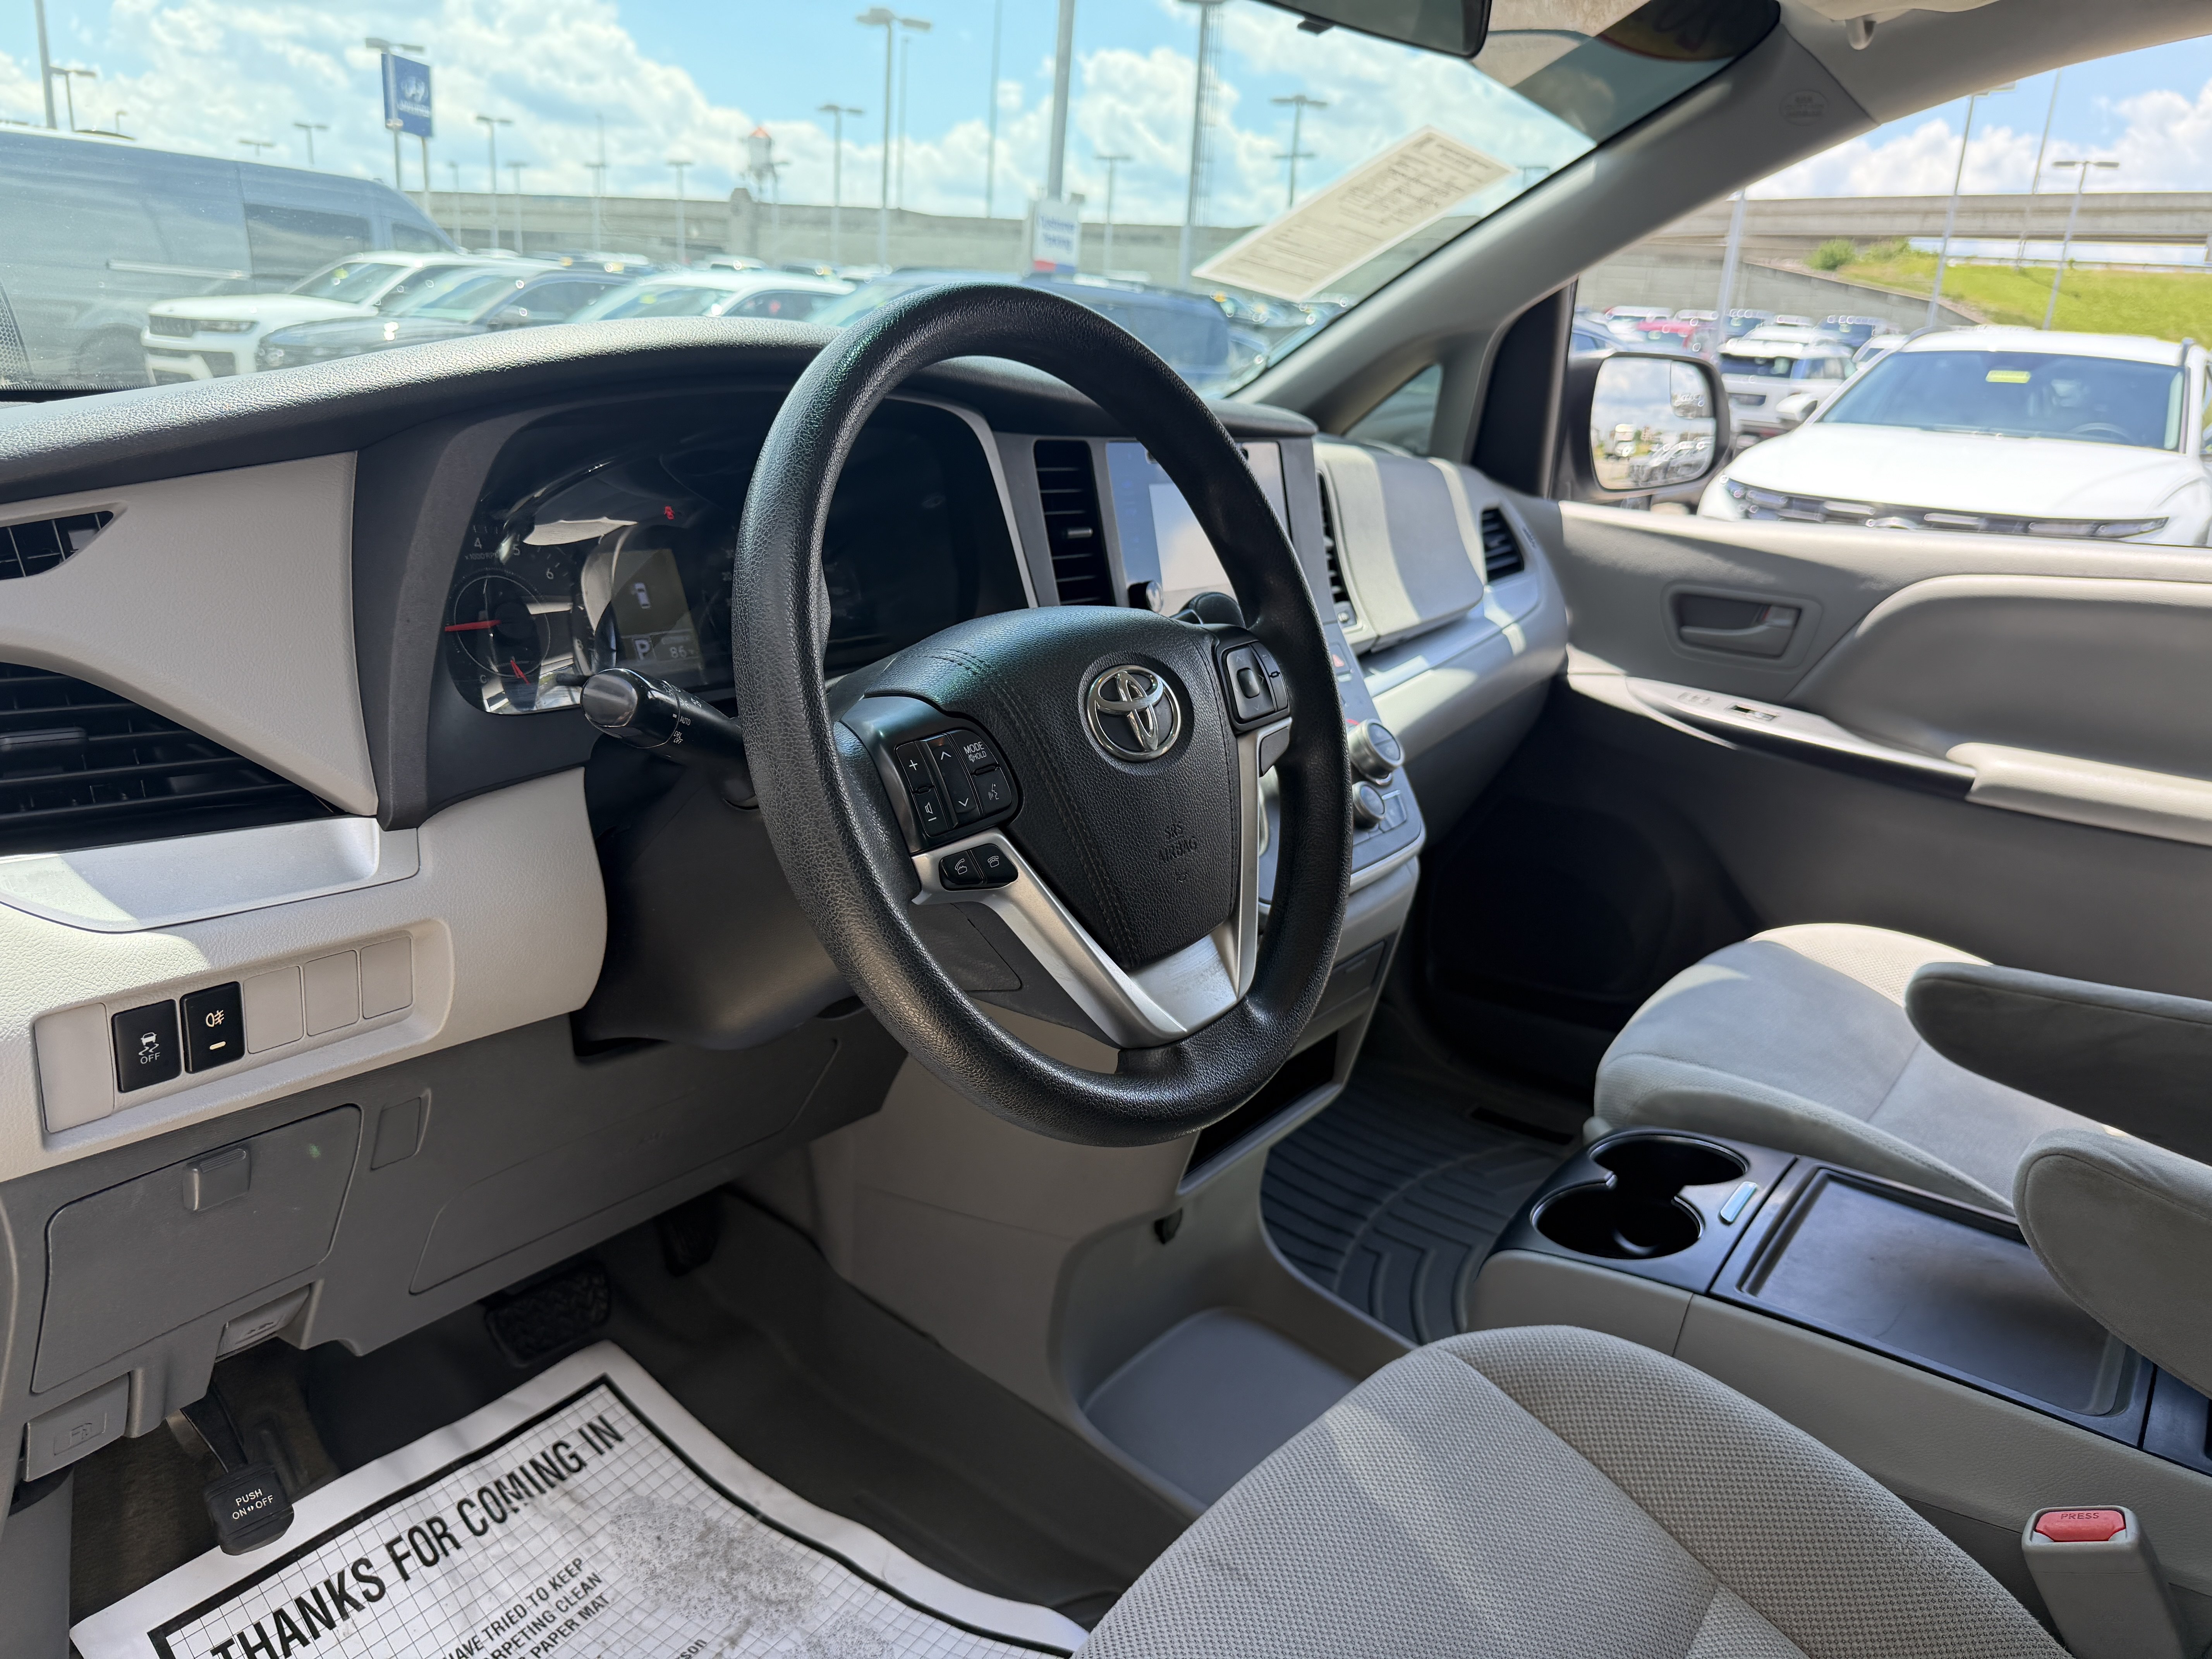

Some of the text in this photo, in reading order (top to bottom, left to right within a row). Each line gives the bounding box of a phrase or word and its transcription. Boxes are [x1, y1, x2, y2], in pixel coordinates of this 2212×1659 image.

[474, 537, 482, 549] 4
[546, 568, 555, 580] 6
[634, 639, 651, 660] P
[679, 716, 691, 726] AUTO
[963, 741, 985, 755] MODE
[972, 750, 987, 760] HOLD
[140, 1052, 161, 1064] OFF
[235, 1489, 263, 1506] PUSH
[385, 1515, 462, 1582] FOR
[457, 1440, 588, 1537] COMING
[577, 1415, 625, 1456] IN
[232, 1495, 273, 1520] ON OFF
[481, 1603, 527, 1641] TRIED
[526, 1586, 549, 1607] TO
[548, 1557, 583, 1591] KEEP
[555, 1572, 603, 1613] CLEAN
[530, 1592, 610, 1659] PAPER MAT
